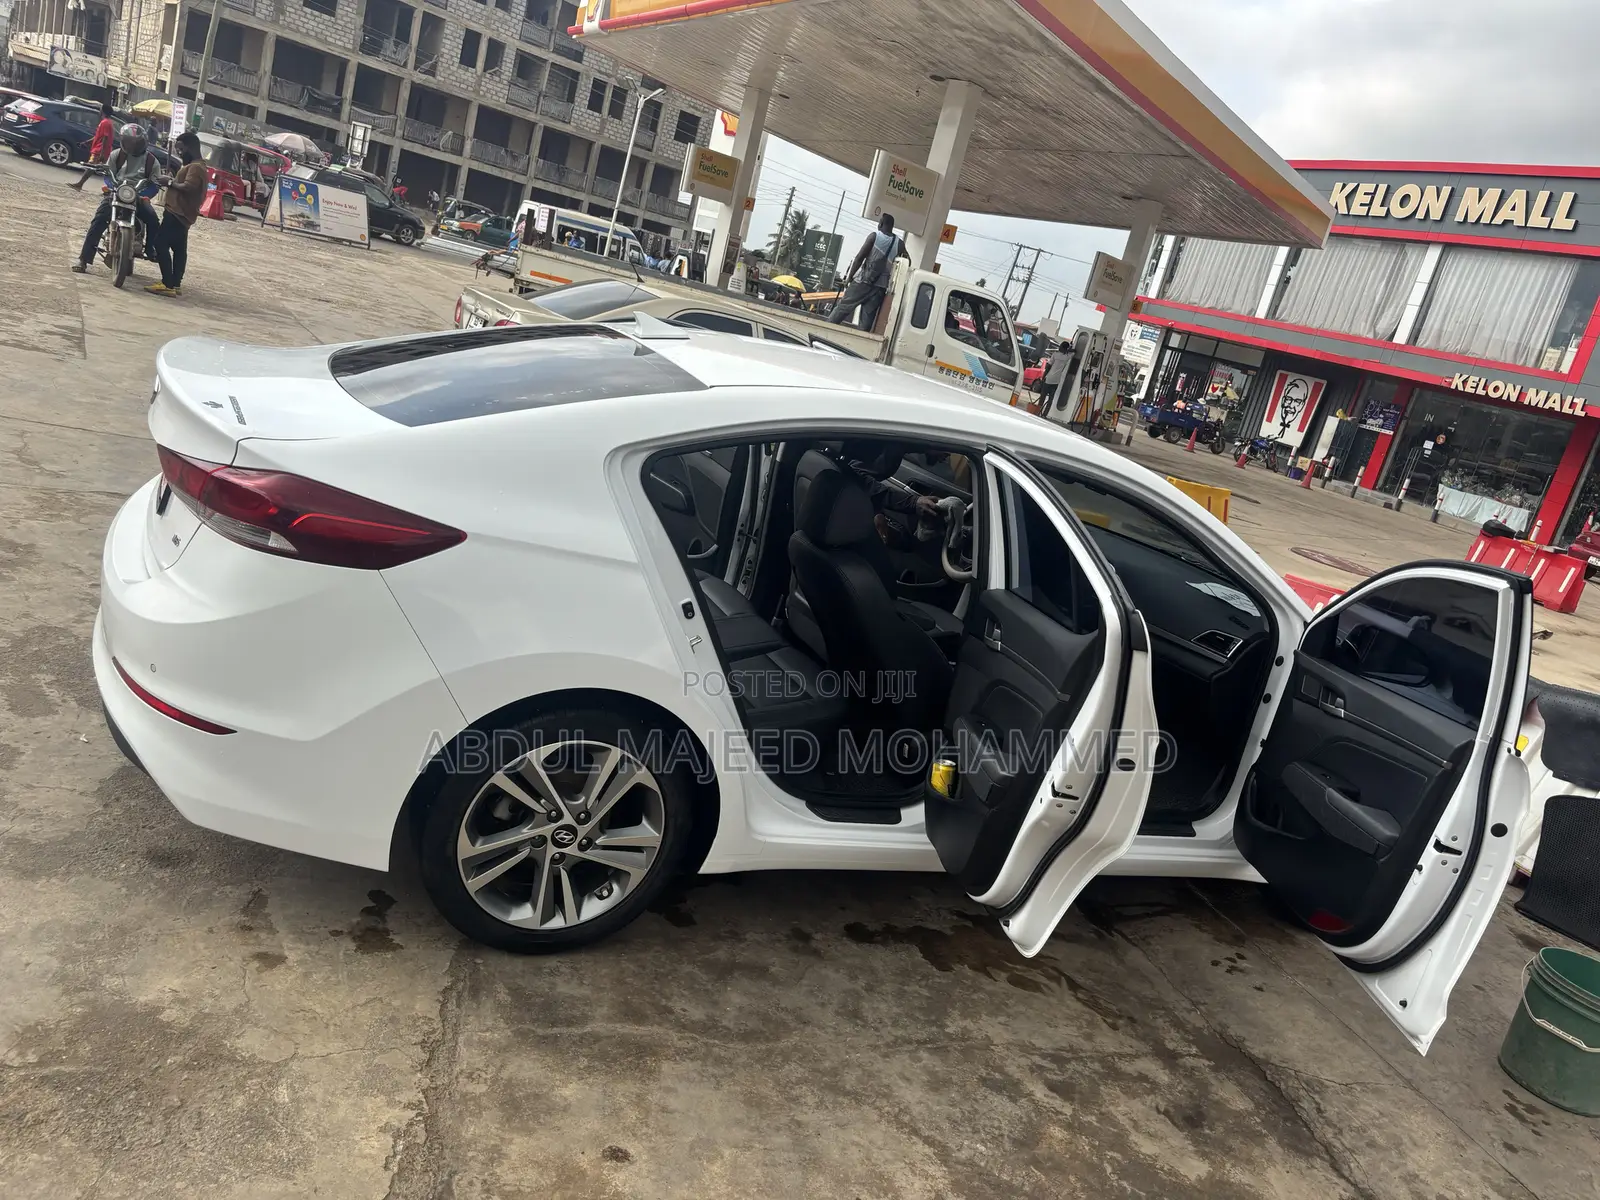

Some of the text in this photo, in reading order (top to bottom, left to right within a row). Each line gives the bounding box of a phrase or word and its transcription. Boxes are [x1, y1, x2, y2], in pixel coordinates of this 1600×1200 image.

[699, 161, 729, 178] FuelSave
[892, 164, 907, 177] Shell
[888, 175, 924, 199] FuelSave
[744, 200, 751, 208] 2
[1329, 182, 1578, 231] KELON MALL
[943, 229, 951, 239] 4
[1450, 372, 1588, 417] KELON MALL
[1424, 413, 1435, 422] IN
